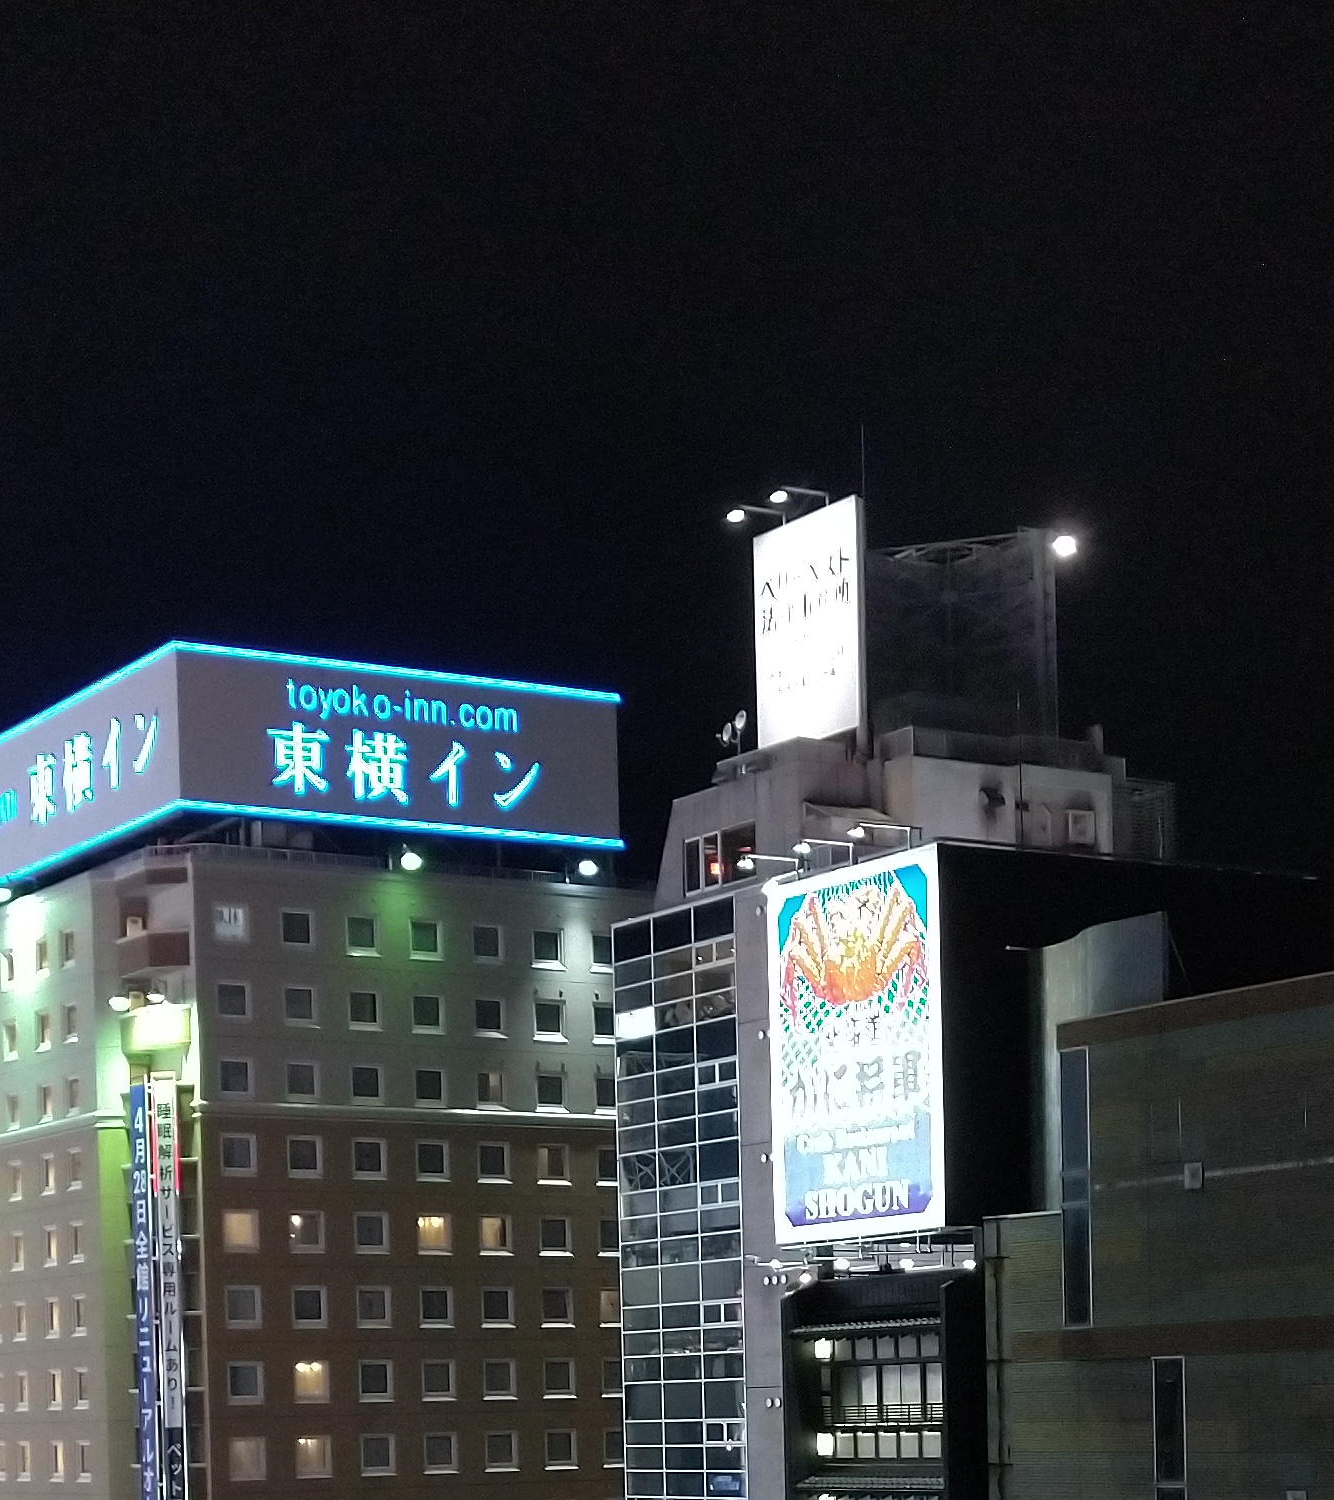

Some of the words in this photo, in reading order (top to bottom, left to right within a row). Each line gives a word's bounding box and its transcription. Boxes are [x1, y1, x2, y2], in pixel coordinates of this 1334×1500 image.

[286, 677, 519, 733] toyoko-inn.com
[27, 709, 160, 824] 東横イン
[267, 721, 540, 809] 東横イン
[804, 1180, 910, 1219] SHOGUN
